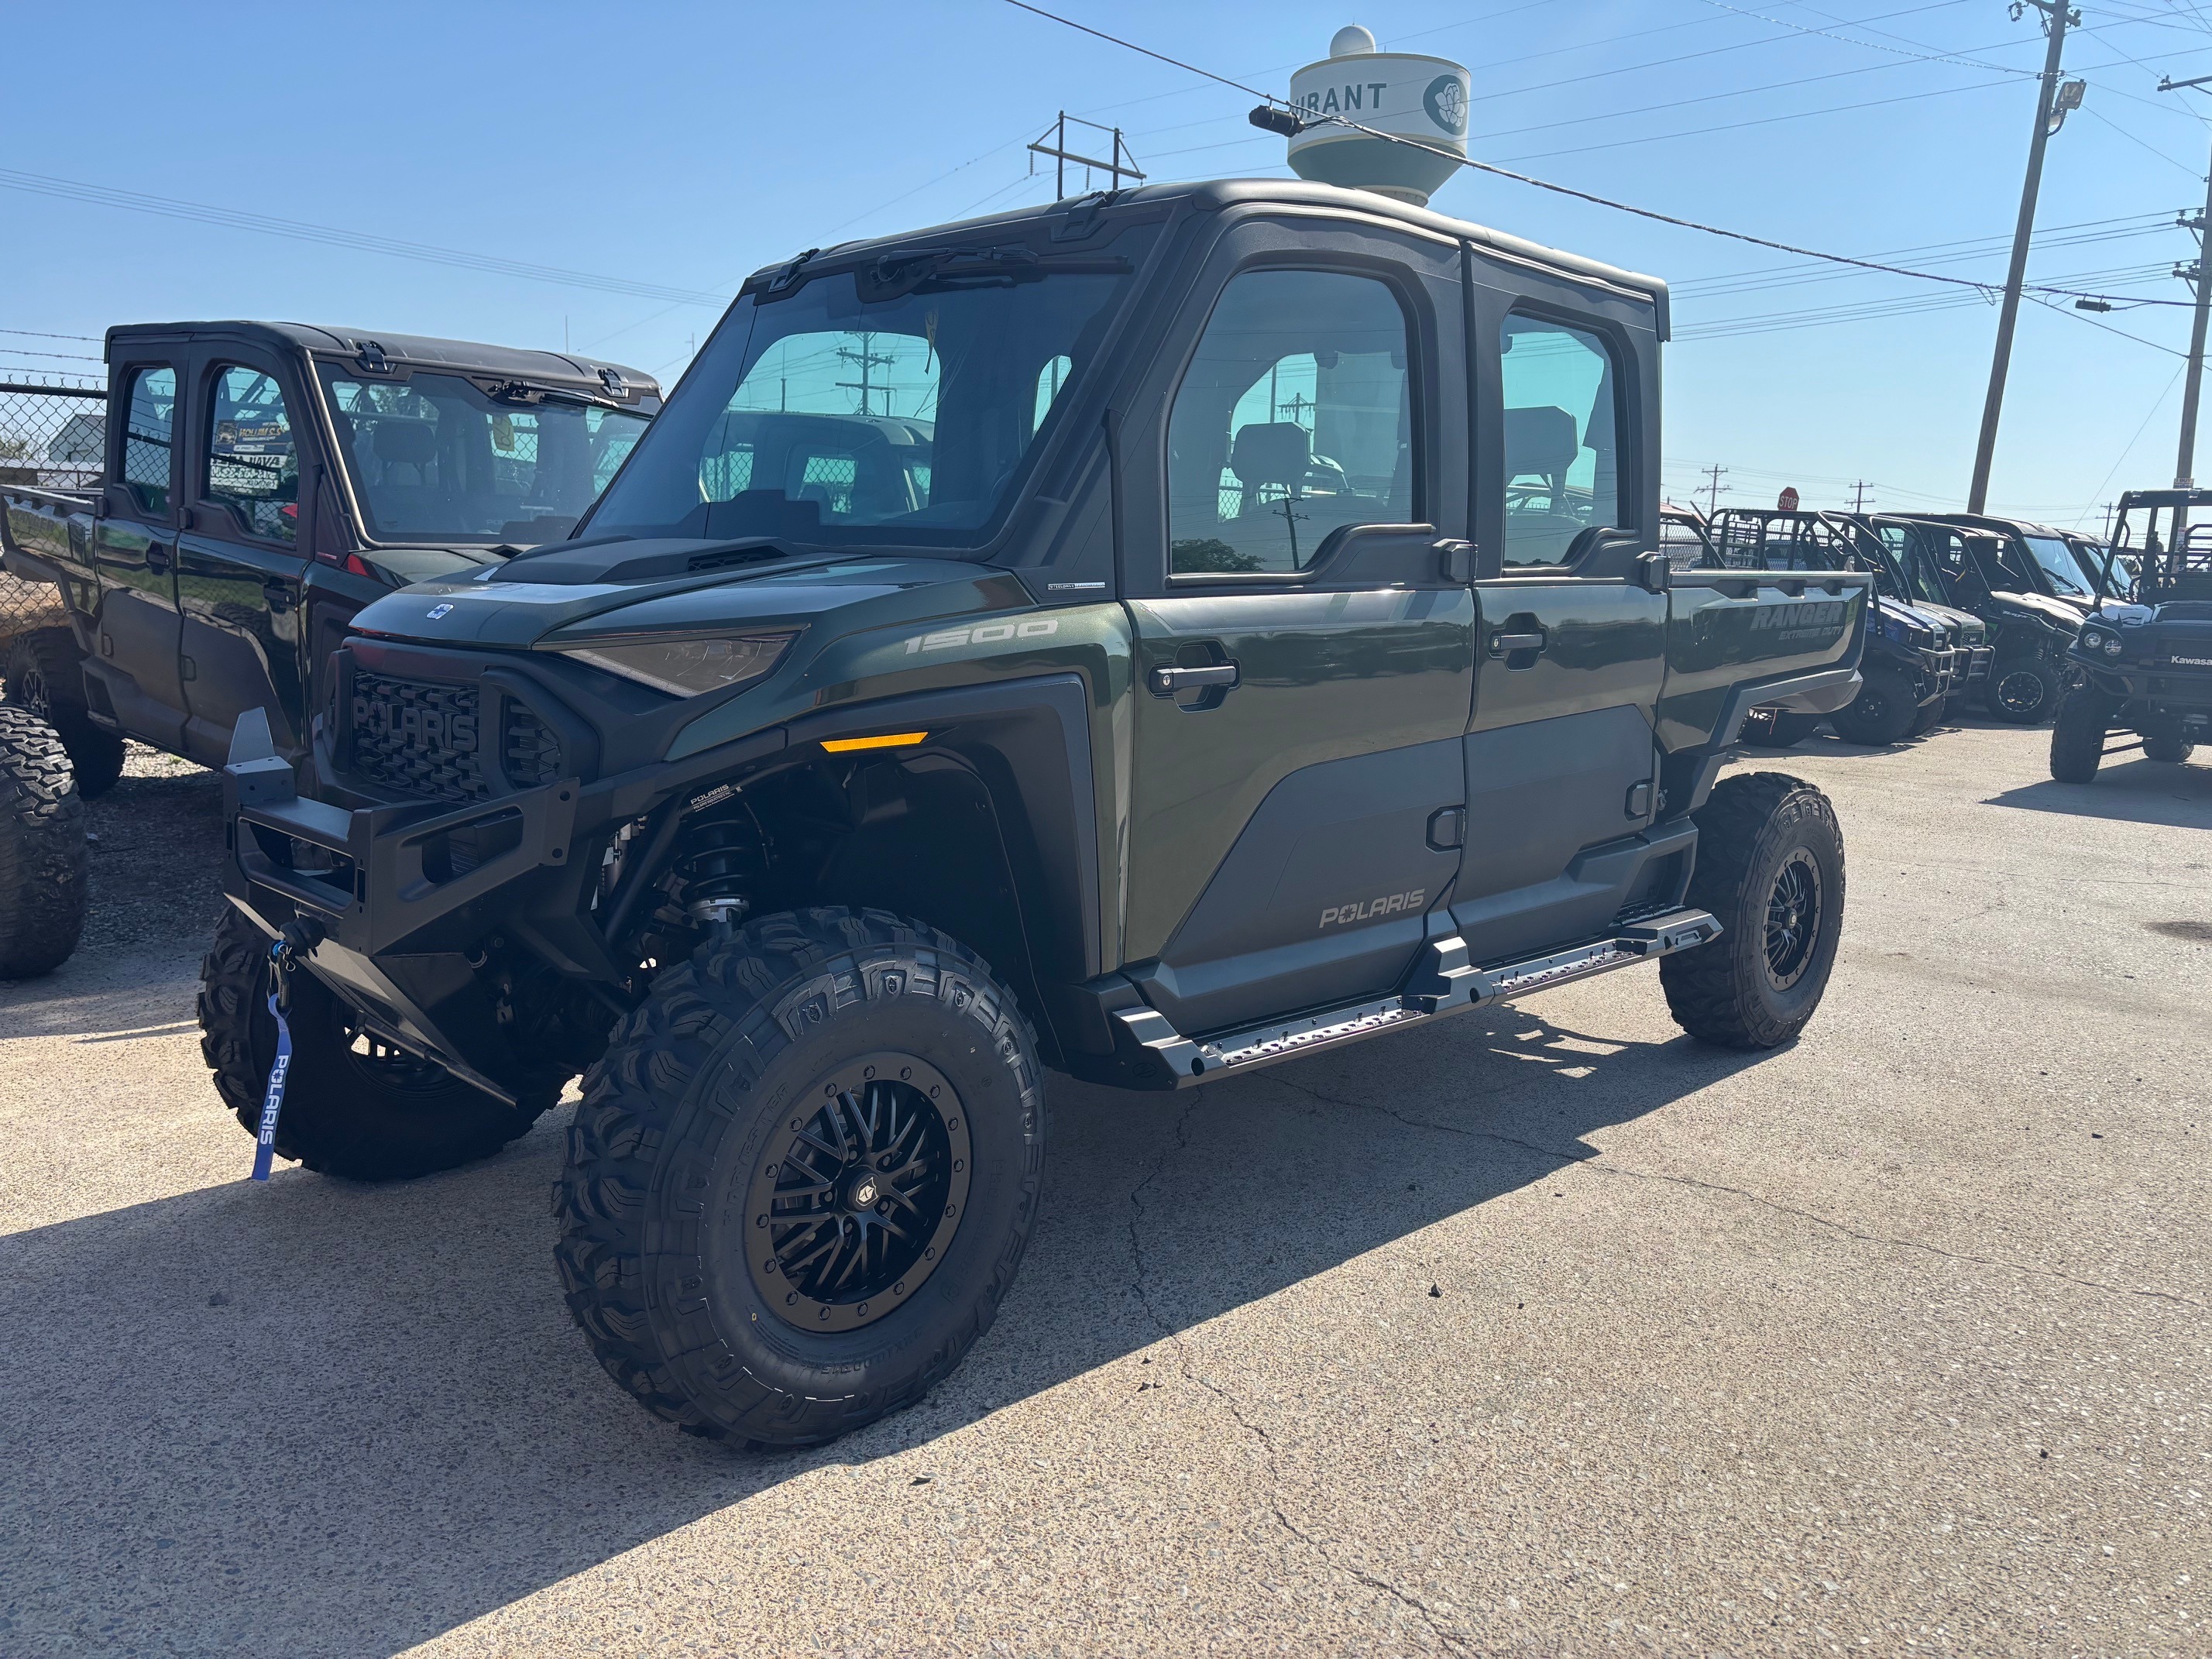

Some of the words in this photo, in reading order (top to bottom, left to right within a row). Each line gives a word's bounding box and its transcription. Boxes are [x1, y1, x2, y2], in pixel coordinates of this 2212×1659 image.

[1779, 496, 1798, 509] STOP
[1749, 602, 1843, 631] RANGER
[905, 620, 1058, 655] 1500
[1778, 628, 1821, 641] EXTREME
[1822, 626, 1843, 636] DUTY
[352, 696, 477, 753] POLARIS
[690, 784, 730, 805] POLARIS
[1318, 888, 1425, 929] POLARIS
[260, 1055, 289, 1146] POLARIS
